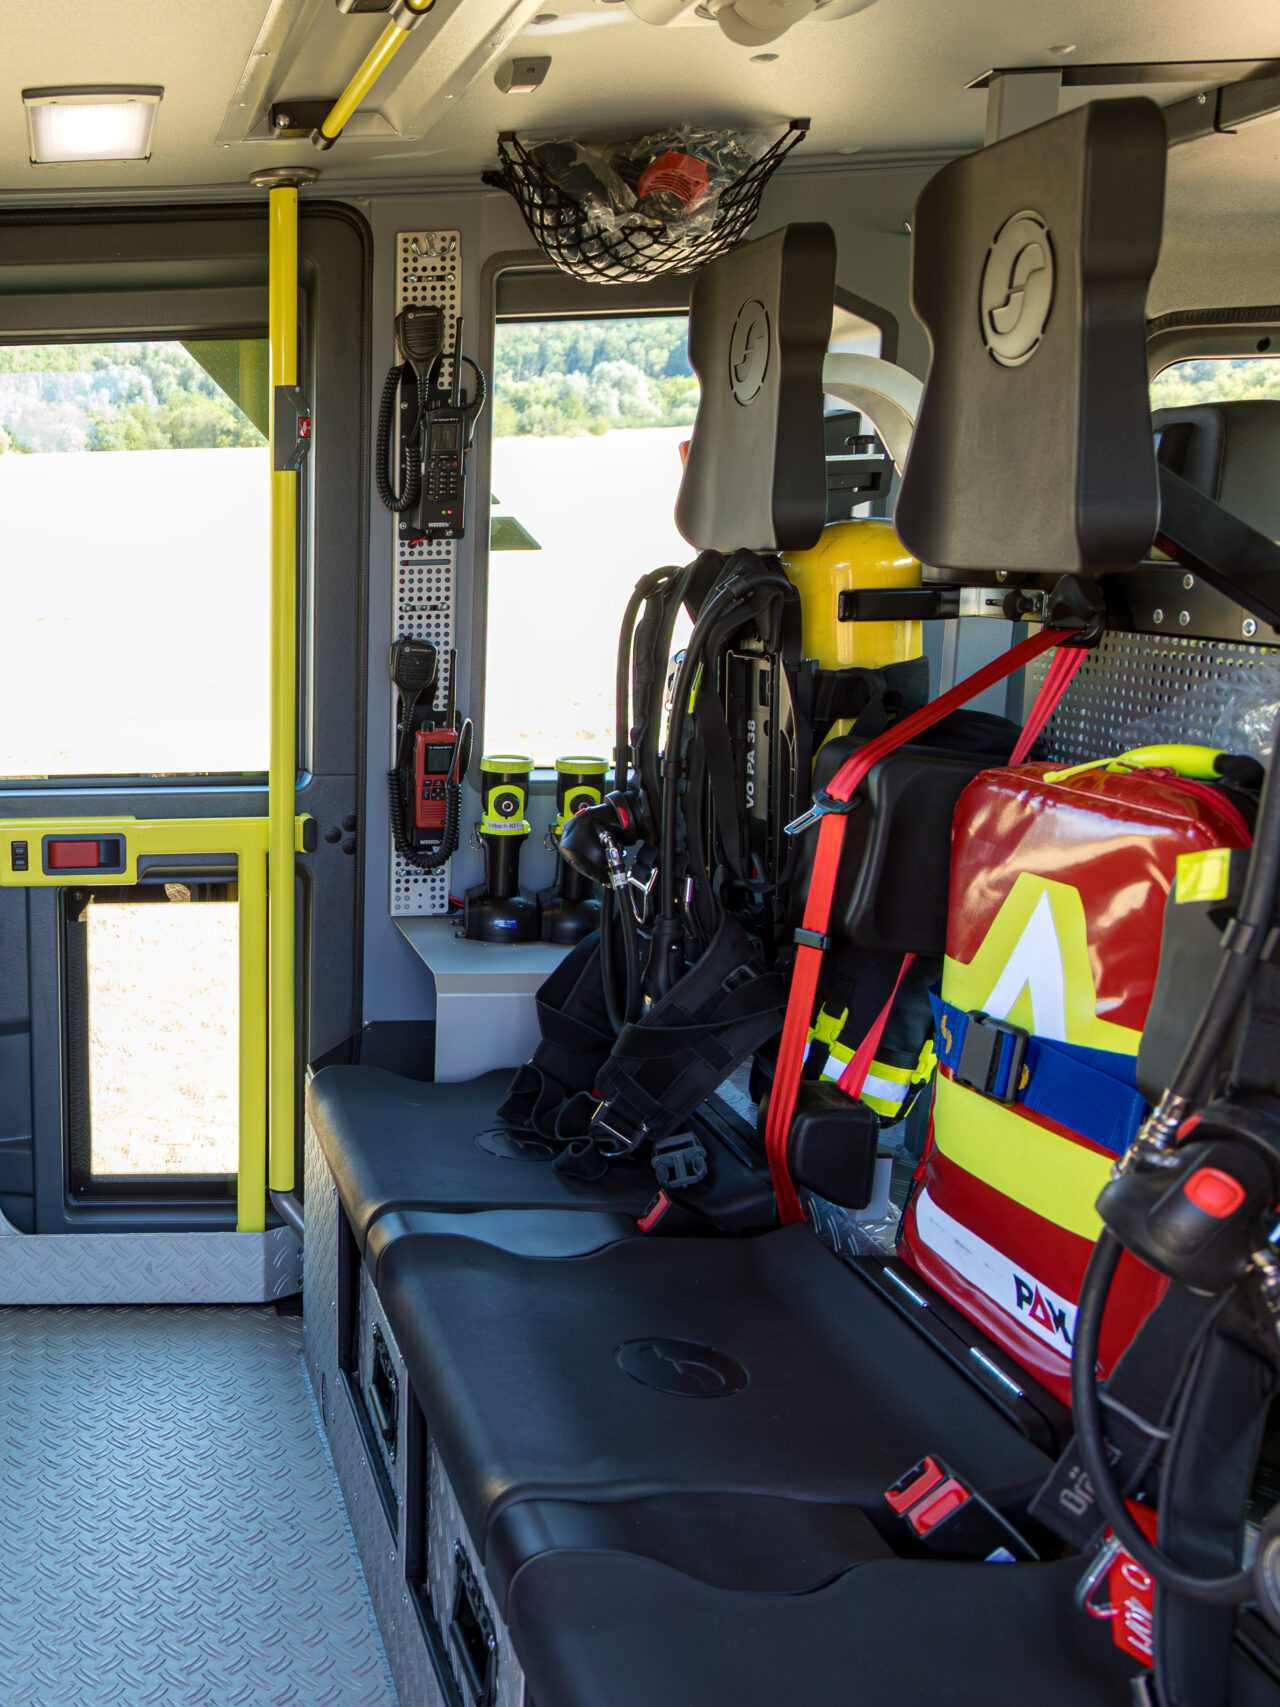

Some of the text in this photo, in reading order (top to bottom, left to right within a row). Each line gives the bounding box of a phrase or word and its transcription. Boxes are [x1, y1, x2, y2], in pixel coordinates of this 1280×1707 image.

[746, 719, 756, 809] VO PA 38
[1013, 1273, 1074, 1346] PAX
